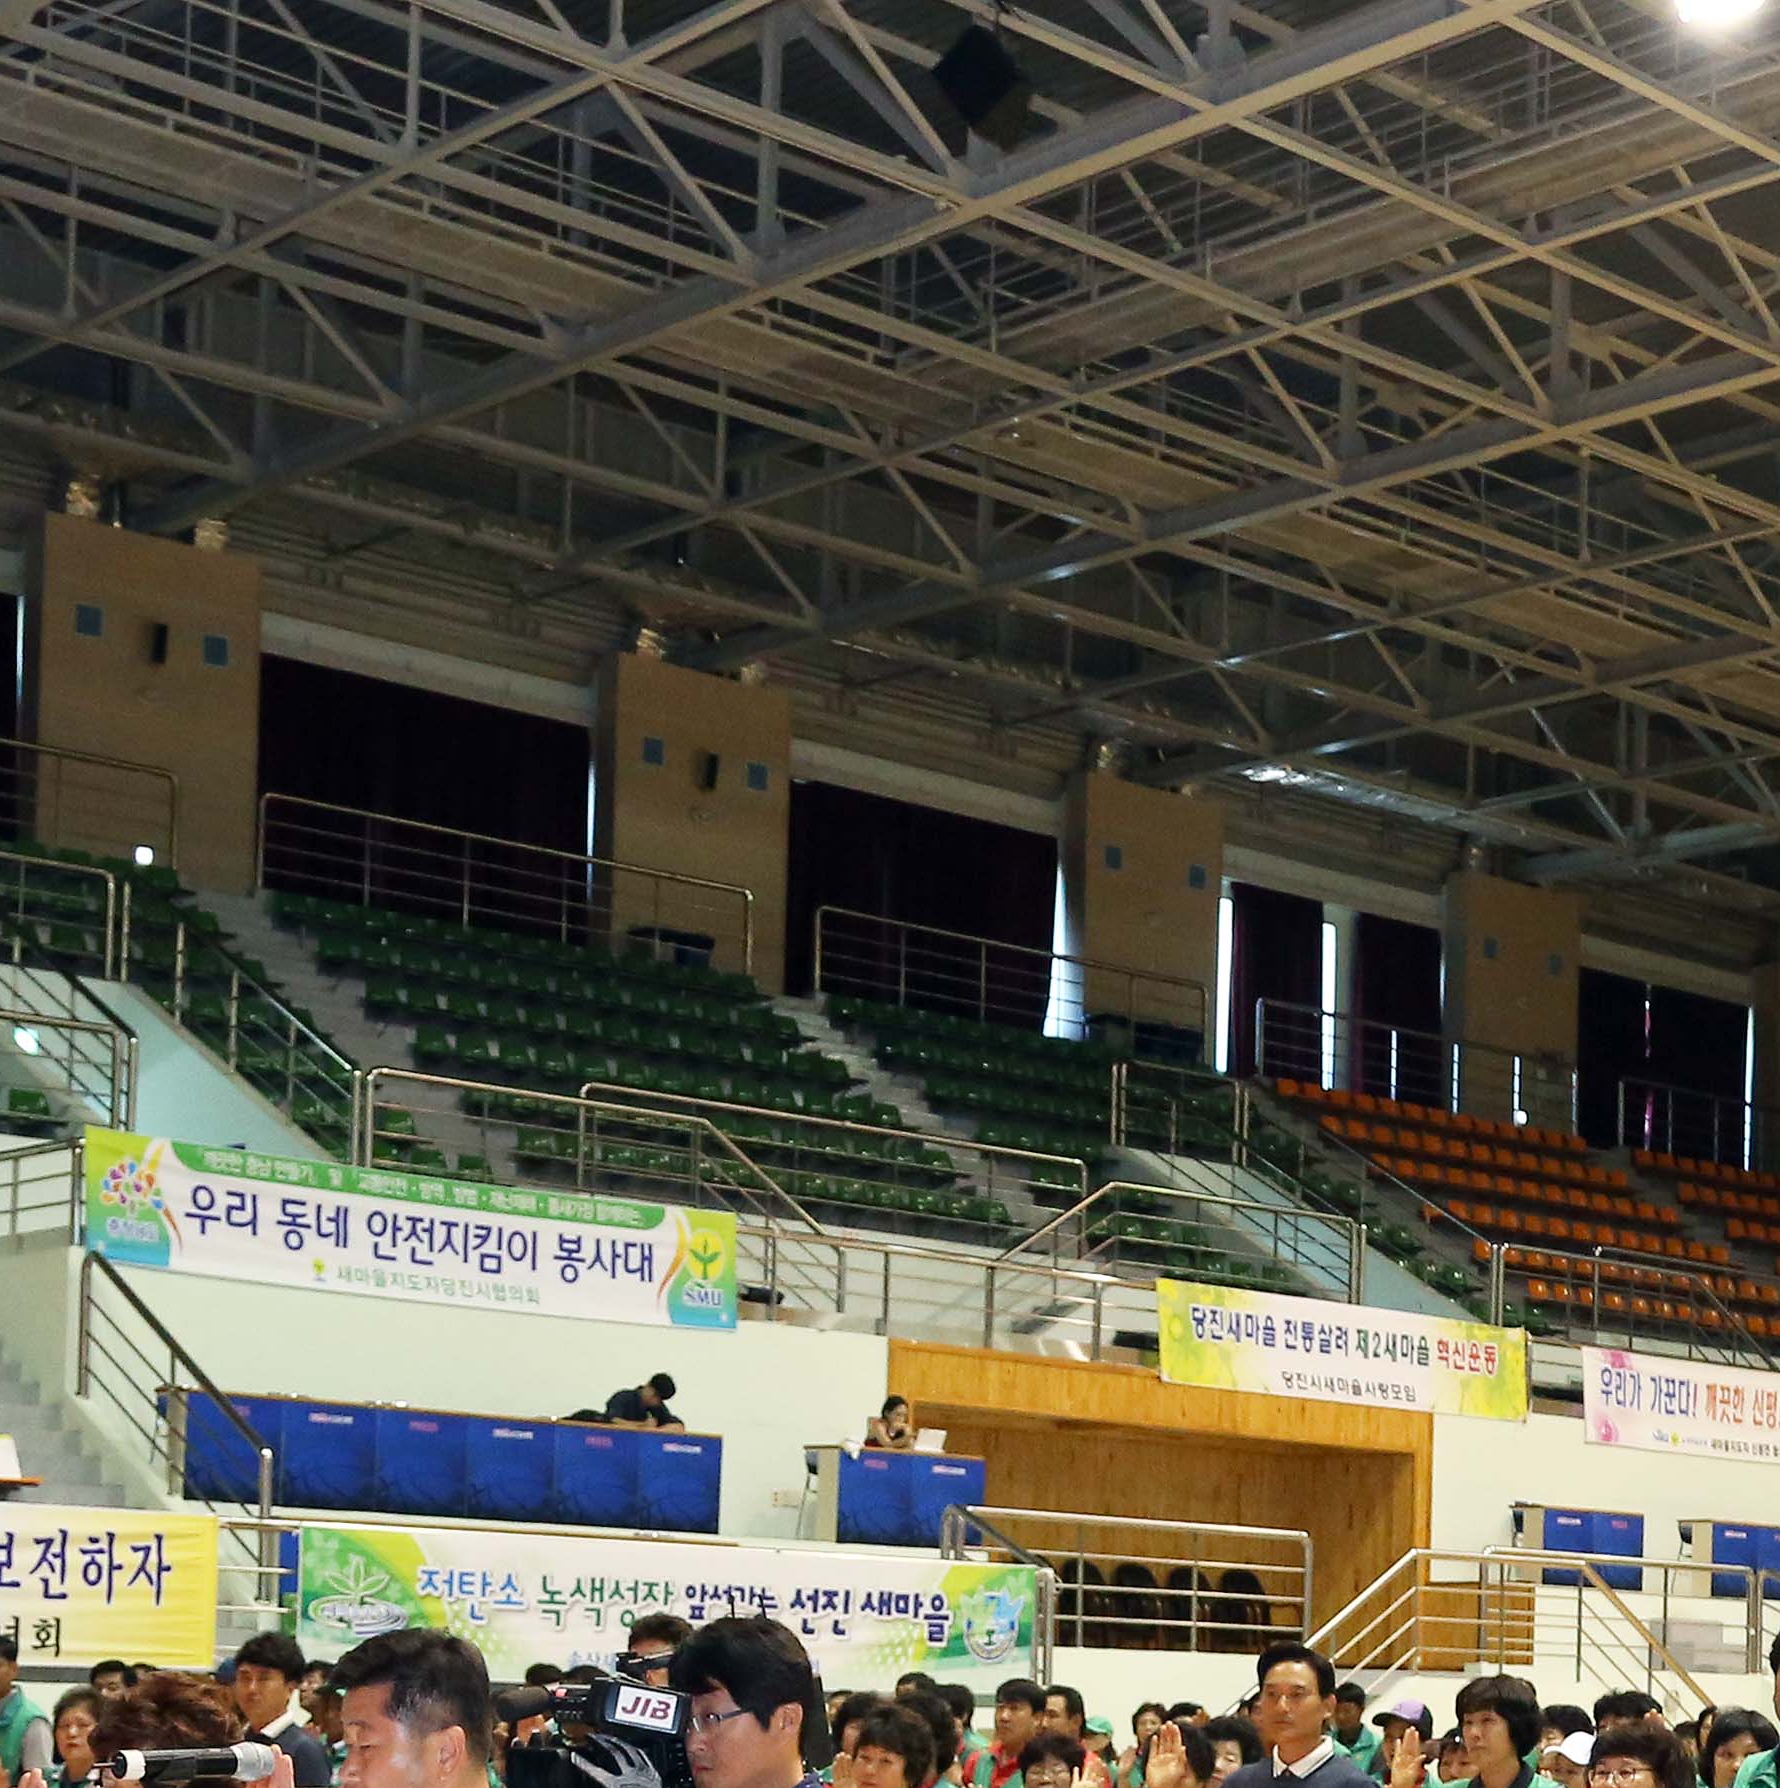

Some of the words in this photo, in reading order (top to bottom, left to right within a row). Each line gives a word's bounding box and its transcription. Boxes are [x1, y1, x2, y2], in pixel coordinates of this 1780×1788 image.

[185, 1185, 258, 1236] 우리
[277, 1198, 348, 1250] 동네
[367, 1210, 537, 1274] 안전지킴이
[554, 1233, 653, 1283] 봉사대
[683, 1288, 723, 1307] SMU
[1191, 1306, 1276, 1347] 당진새마을
[1284, 1320, 1349, 1356] 전통살려
[1356, 1328, 1430, 1367] 제2새마을
[1601, 1366, 1642, 1411] 우리가
[1651, 1376, 1697, 1417] 가꾼다!
[1706, 1384, 1745, 1425] 깨끗한
[418, 1567, 525, 1624] 저탄소
[789, 1587, 852, 1636] 선진
[860, 1588, 952, 1643] 새마을
